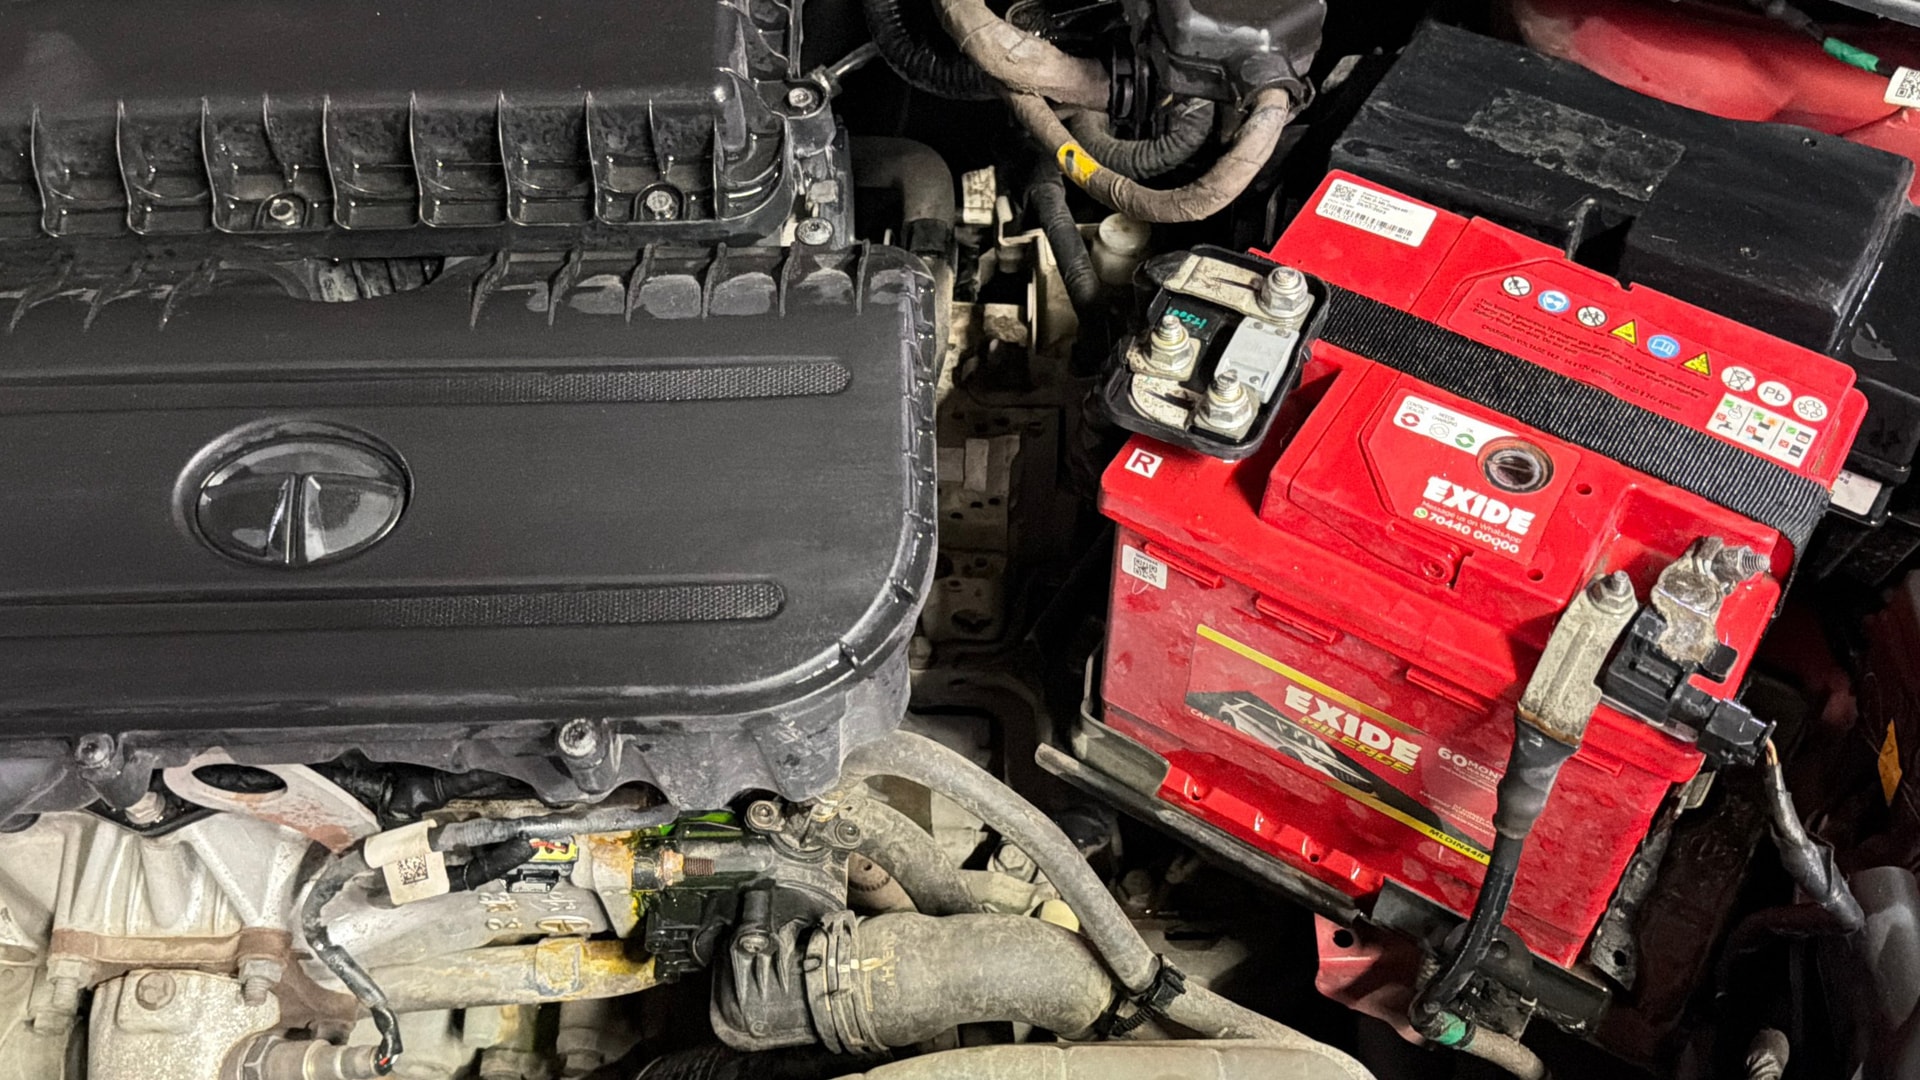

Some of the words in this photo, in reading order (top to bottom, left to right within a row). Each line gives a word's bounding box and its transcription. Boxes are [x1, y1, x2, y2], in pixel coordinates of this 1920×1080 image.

[1763, 385, 1786, 402] Pb
[1131, 451, 1155, 474] R
[1421, 500, 1456, 519] Message
[1455, 513, 1467, 523] us
[1467, 517, 1478, 527] on
[1478, 522, 1522, 544] WhatsApp
[1422, 475, 1536, 536] EXIDE
[1428, 512, 1471, 535] 70440
[1473, 529, 1520, 554] 00000
[1190, 708, 1211, 722] CAR
[1284, 684, 1422, 767] EXIDE
[1299, 715, 1415, 775] MILEAGE
[1437, 747, 1468, 768] 60
